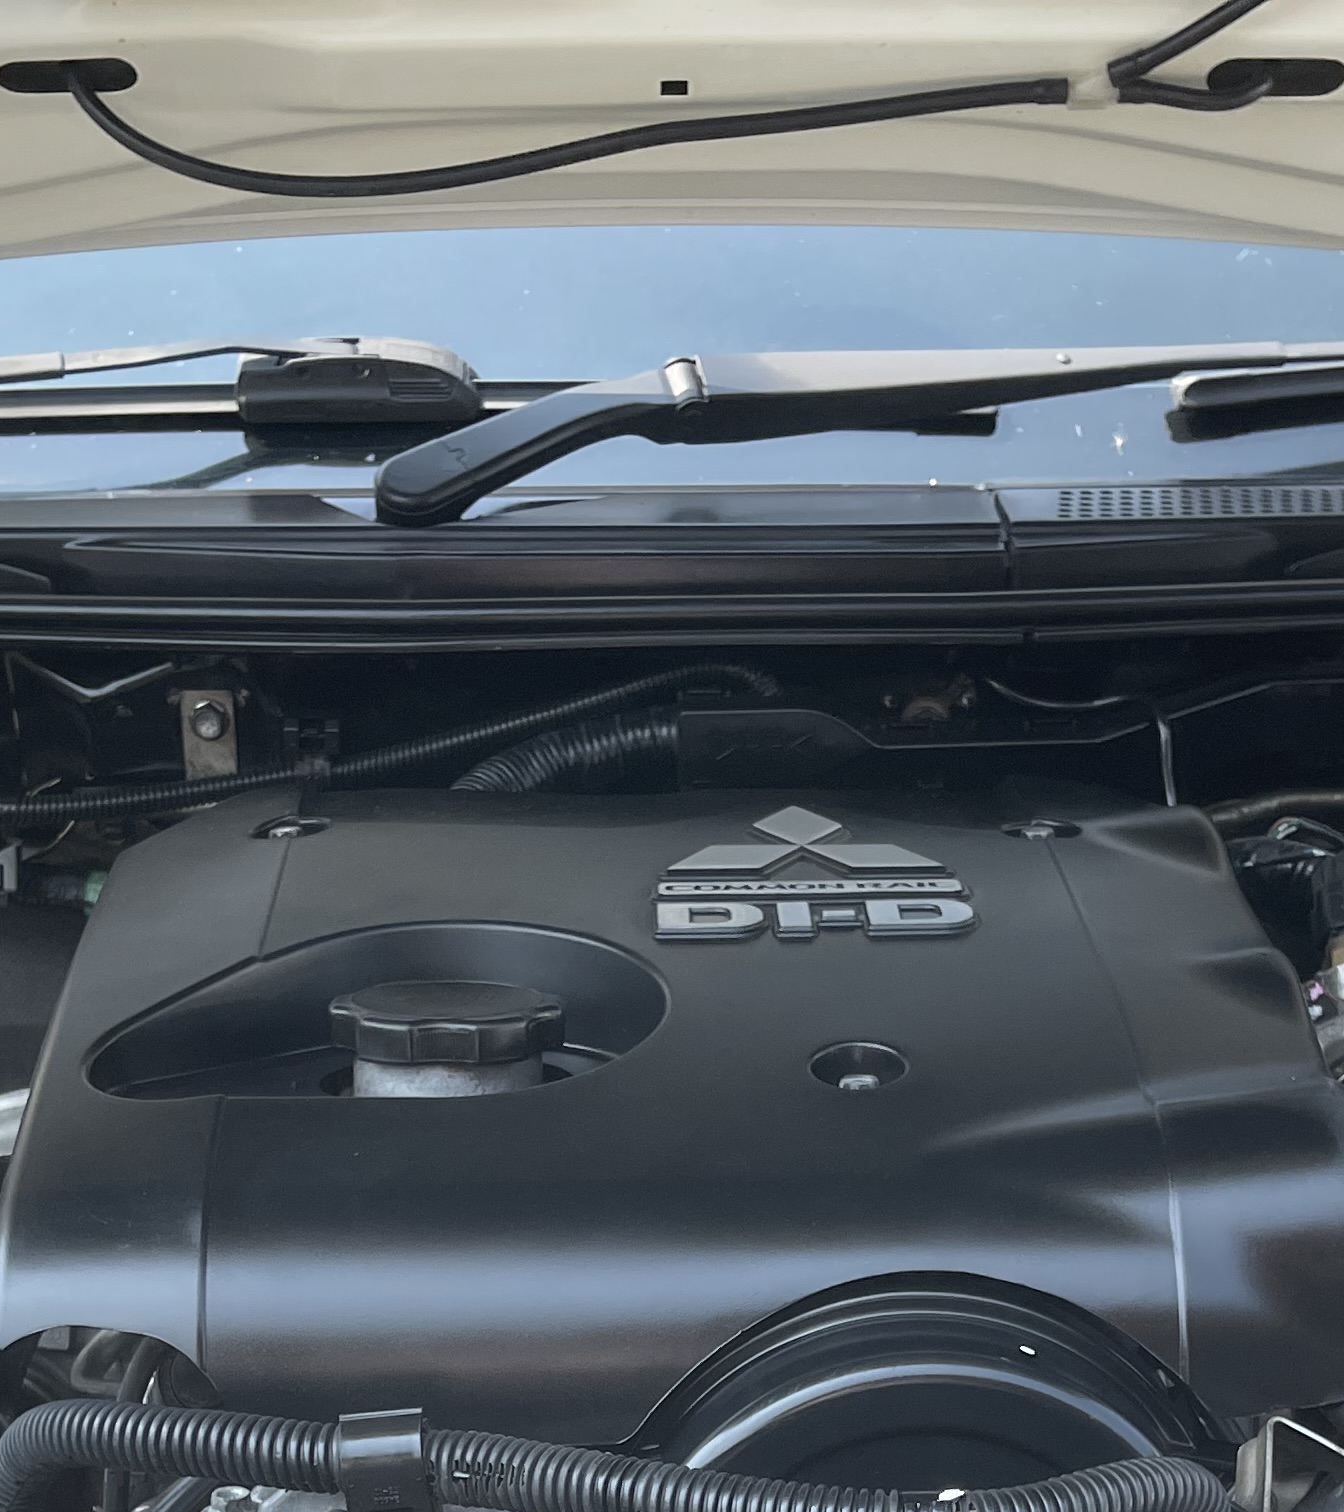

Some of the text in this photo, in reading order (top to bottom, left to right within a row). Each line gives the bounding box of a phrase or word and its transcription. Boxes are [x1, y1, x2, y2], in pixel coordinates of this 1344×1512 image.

[664, 880, 958, 892] COMMON RAIL
[656, 900, 974, 938] DI-D
